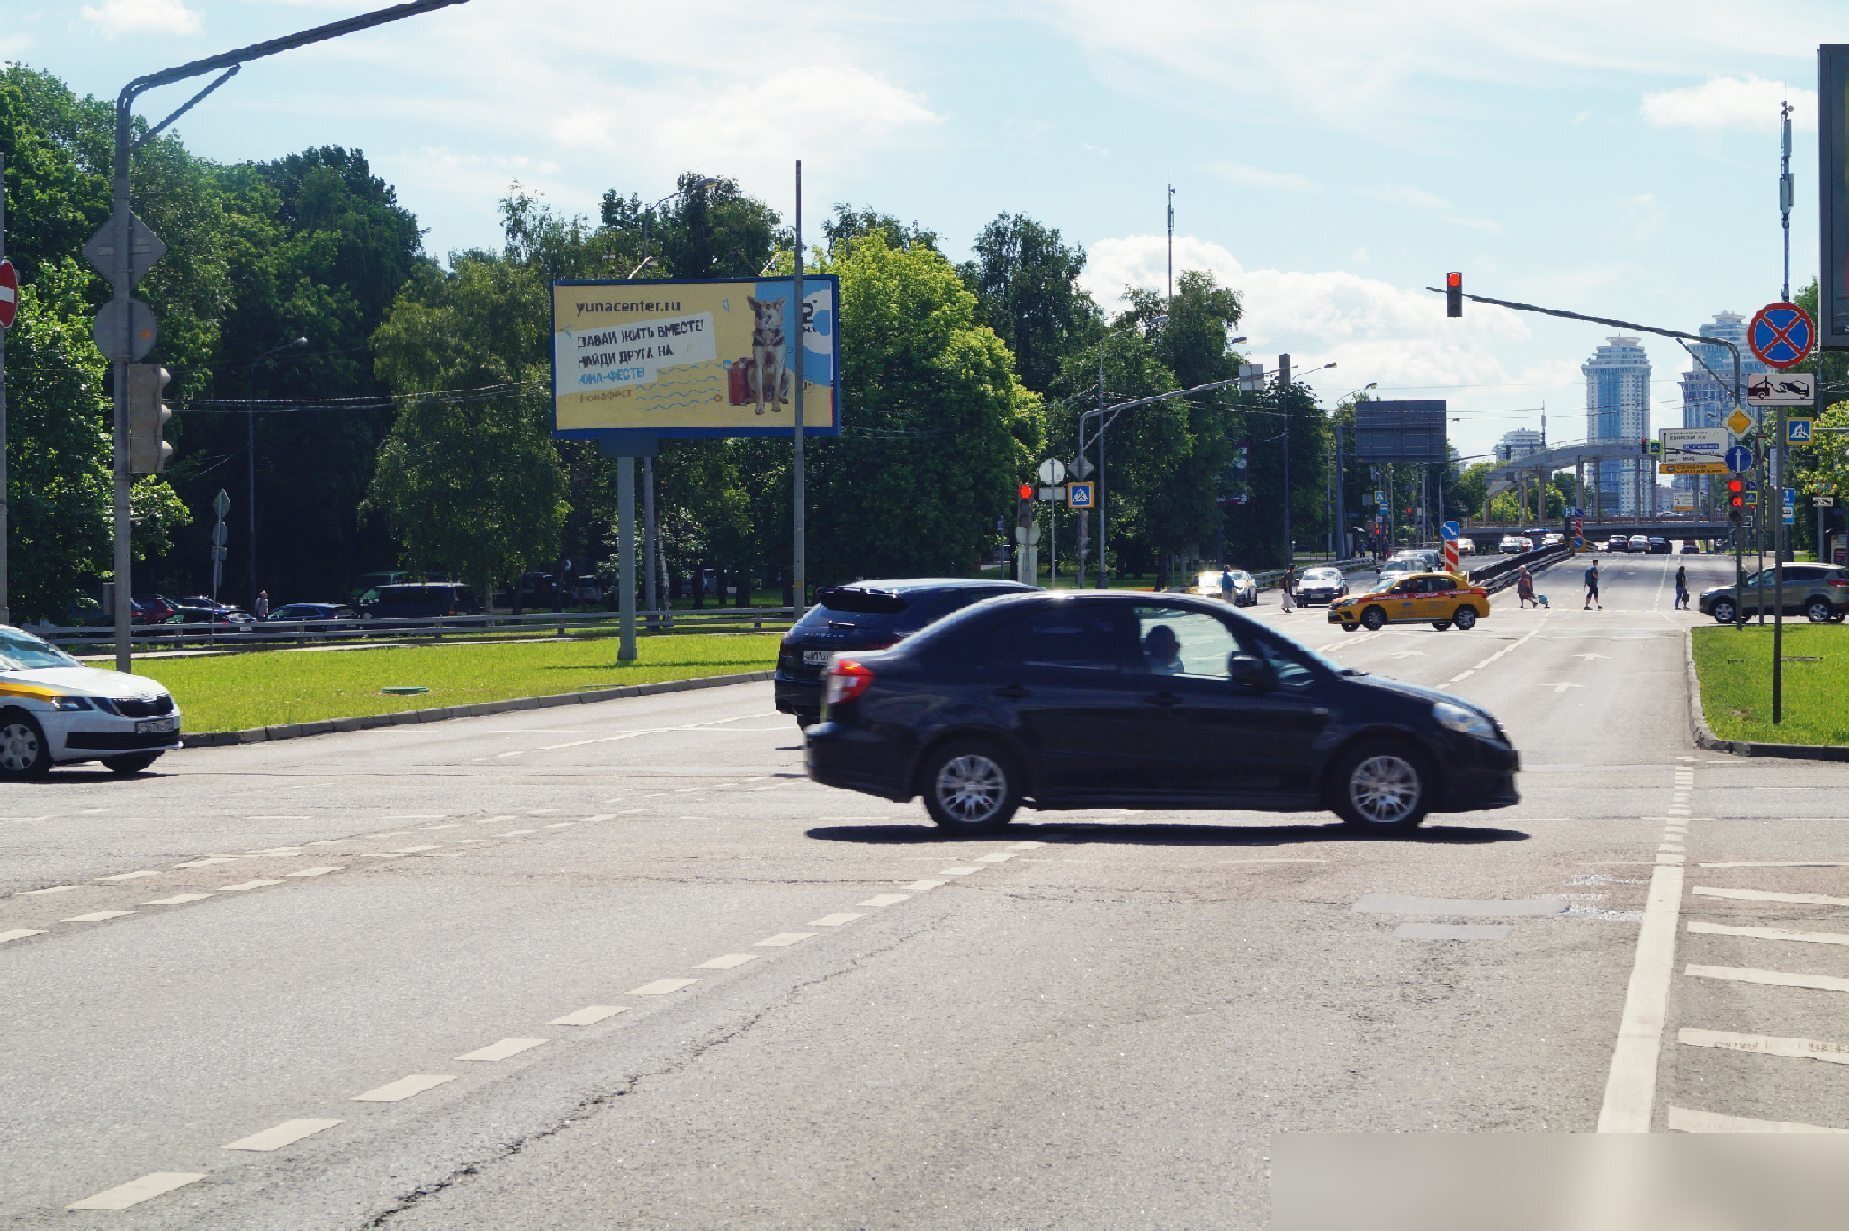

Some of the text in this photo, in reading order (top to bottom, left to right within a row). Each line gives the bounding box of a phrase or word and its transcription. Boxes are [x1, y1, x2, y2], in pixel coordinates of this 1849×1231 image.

[576, 301, 681, 318] yunacenter.ru
[622, 327, 655, 344] ЖИТЬ
[578, 344, 675, 369] НАЙДИ ДРУГА НА
